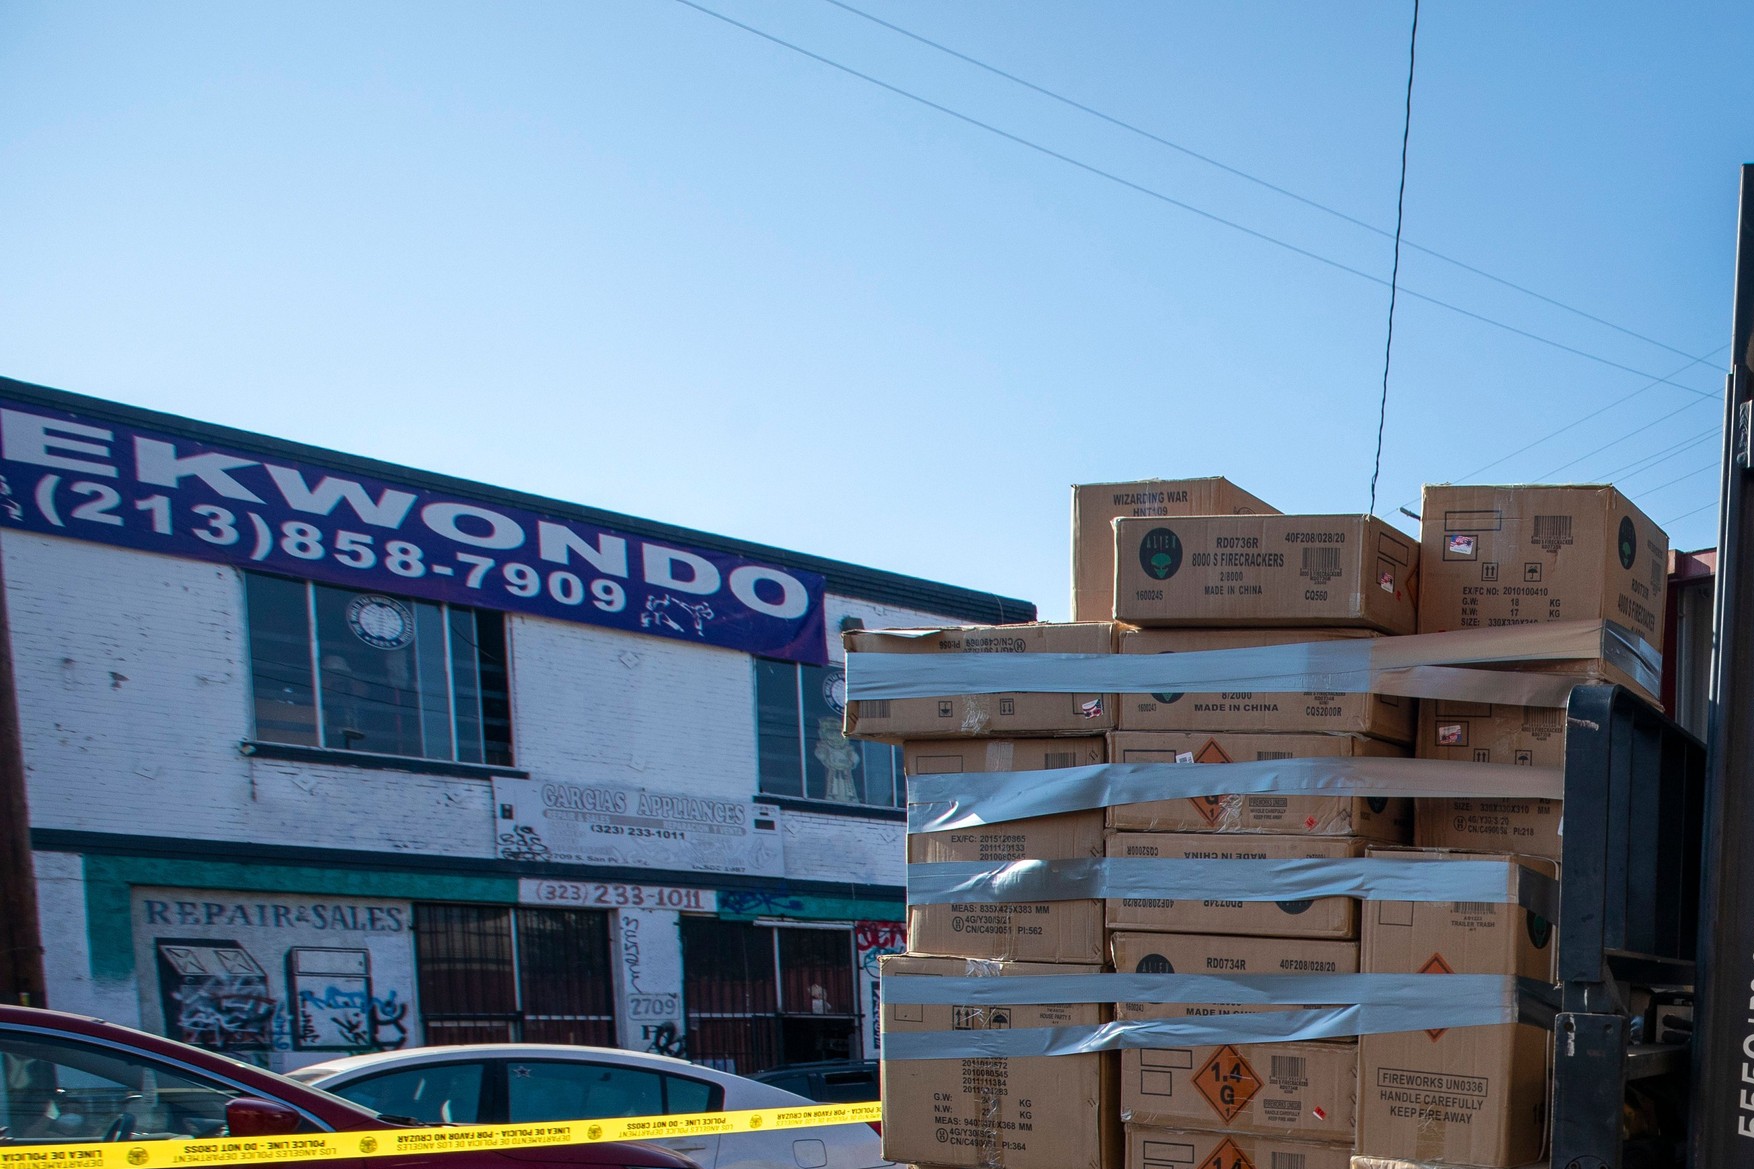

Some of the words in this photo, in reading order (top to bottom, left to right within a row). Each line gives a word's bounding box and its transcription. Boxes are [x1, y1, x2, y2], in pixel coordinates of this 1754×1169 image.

[1113, 493, 1164, 505] WIZARDING
[1167, 491, 1188, 503] WAR
[1133, 507, 1168, 517] HNT109
[1285, 533, 1345, 543] 40F208/028/20
[35, 474, 627, 613] (213)858-7909
[1216, 538, 1258, 549] RD0736R
[1192, 553, 1211, 566] 8000
[1213, 554, 1218, 566] S
[1221, 553, 1284, 567] FIRECRACKERS
[1221, 572, 1243, 582] 2/8000
[1136, 590, 1163, 600] 1600245
[1204, 586, 1224, 595] MADE
[1227, 586, 1235, 595] IN
[1238, 585, 1262, 595] CHINA
[1463, 587, 1484, 595] EX/FC
[1486, 587, 1499, 596] NO:
[1503, 587, 1548, 596] 2010100410
[1305, 590, 1327, 601] CQ560
[1462, 598, 1478, 606] G.W:
[1550, 599, 1560, 607] KG
[1461, 607, 1477, 616] N.W:
[1549, 609, 1560, 617] KG
[1461, 618, 1480, 626] SIZE:
[1194, 704, 1226, 712] MADE
[1229, 704, 1243, 712] IN
[1246, 704, 1279, 712] CHINA
[1306, 706, 1342, 717] CQS2000R
[541, 784, 627, 814] GARCIAS
[637, 794, 746, 826] APPLIANCES
[1538, 806, 1550, 814] MM
[591, 824, 624, 835] (323)
[628, 828, 686, 840] 233-1011
[951, 835, 977, 843] EX/FC:
[537, 881, 588, 901] (323)
[594, 884, 703, 909] 233-1011
[951, 904, 977, 912] MEAS:
[1035, 906, 1049, 914] MM
[145, 900, 294, 927] REPAIR
[312, 905, 402, 932] SALES
[1018, 926, 1042, 935] PI:562
[1206, 957, 1246, 970] RD0734R
[1280, 959, 1336, 972] 40F208/028/20
[631, 999, 675, 1014] 2709
[962, 1069, 1008, 1078] 2010080545
[1211, 1062, 1242, 1083] 1.4
[1382, 1073, 1443, 1089] FIREWORKS
[1446, 1078, 1483, 1093] UN0336
[1220, 1085, 1235, 1105] G
[1380, 1090, 1421, 1104] HANDLE
[1423, 1094, 1483, 1111] CAREFULLY
[1390, 1105, 1417, 1118] KEEP
[1419, 1108, 1441, 1121] FIRE
[1443, 1111, 1472, 1124] AWAY
[502, 1128, 532, 1137] POLICIA
[547, 1126, 570, 1134] LINEA
[397, 1134, 431, 1142] CRUZAR
[448, 1132, 474, 1140] FAVOR
[512, 1135, 570, 1145] DEPARTAMENTO
[243, 1142, 257, 1151] DO
[268, 1141, 289, 1150] LINE
[292, 1140, 325, 1149] POLICE
[397, 1142, 434, 1151] ANGELES
[438, 1141, 454, 1149] LOS
[456, 1140, 465, 1148] DE
[468, 1139, 497, 1147] POLICIA
[500, 1138, 510, 1146] DE
[1002, 1141, 1026, 1150] PI:364
[184, 1145, 217, 1154] CROSS
[221, 1143, 241, 1153] NOT
[275, 1148, 317, 1158] ANGELES
[320, 1147, 337, 1156] LOS
[2, 1152, 48, 1162] POLICIA
[50, 1151, 66, 1160] DE
[69, 1150, 102, 1159] LINEA
[172, 1152, 239, 1163] DEPARTMENT
[242, 1150, 272, 1160] POLICE
